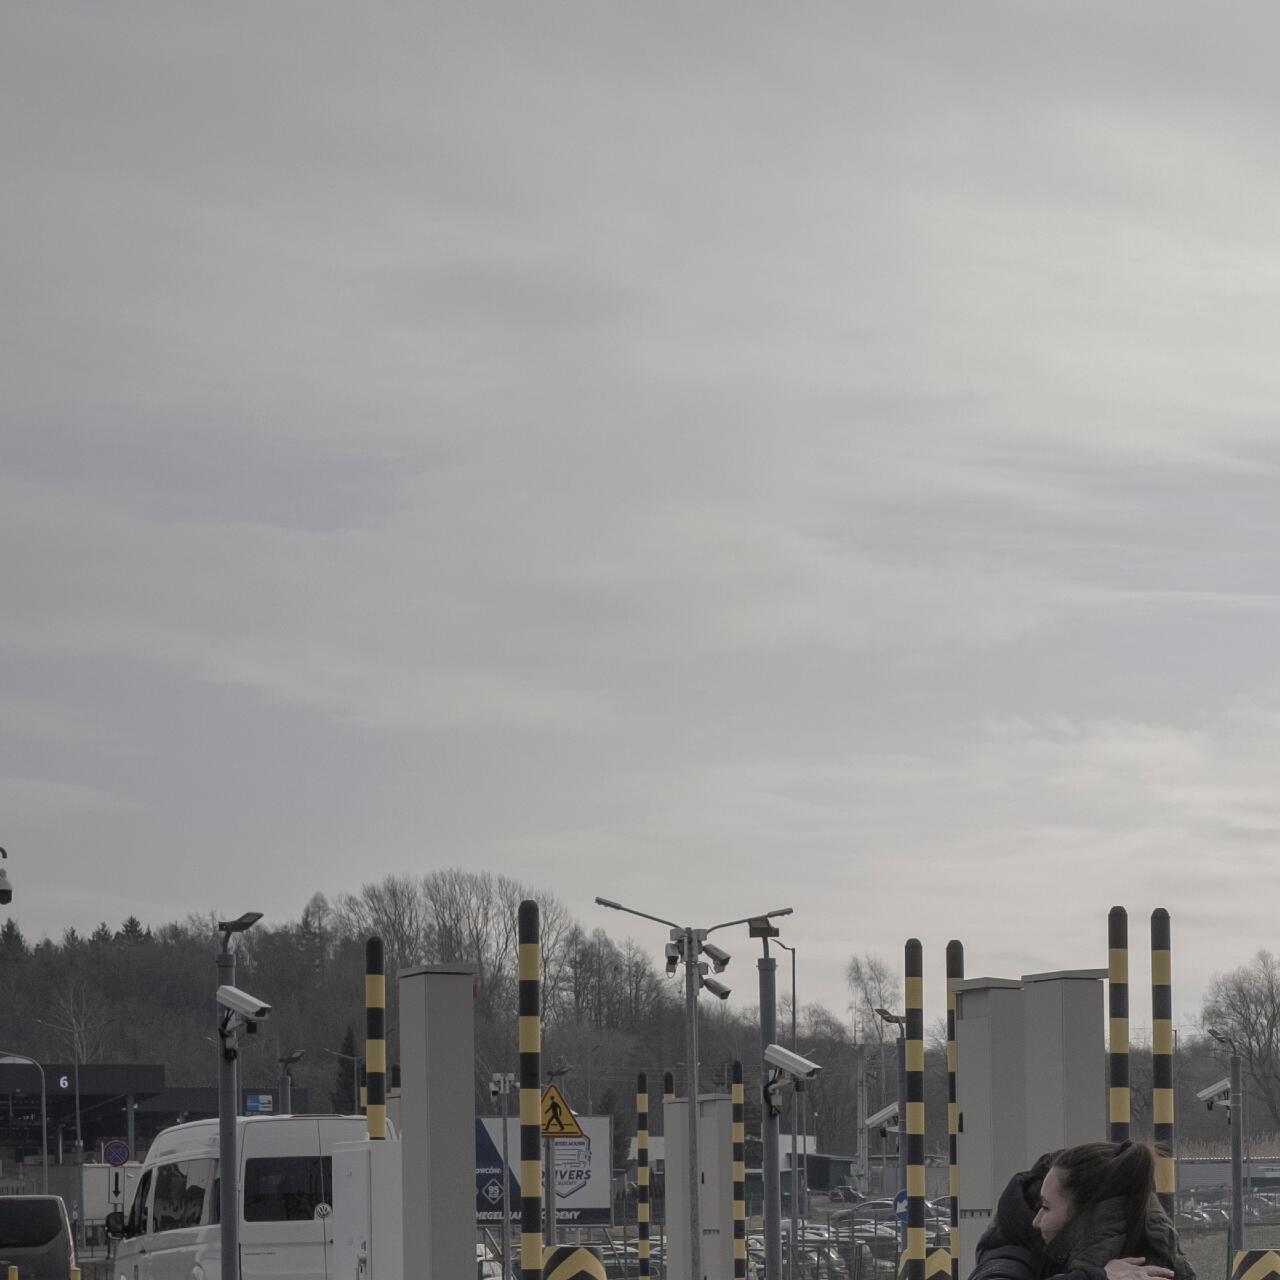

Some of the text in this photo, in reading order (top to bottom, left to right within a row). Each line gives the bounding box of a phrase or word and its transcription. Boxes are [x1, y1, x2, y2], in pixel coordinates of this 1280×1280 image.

[60, 1076, 68, 1088] 6
[541, 1169, 592, 1180] IVERS
[488, 1185, 499, 1194] 95
